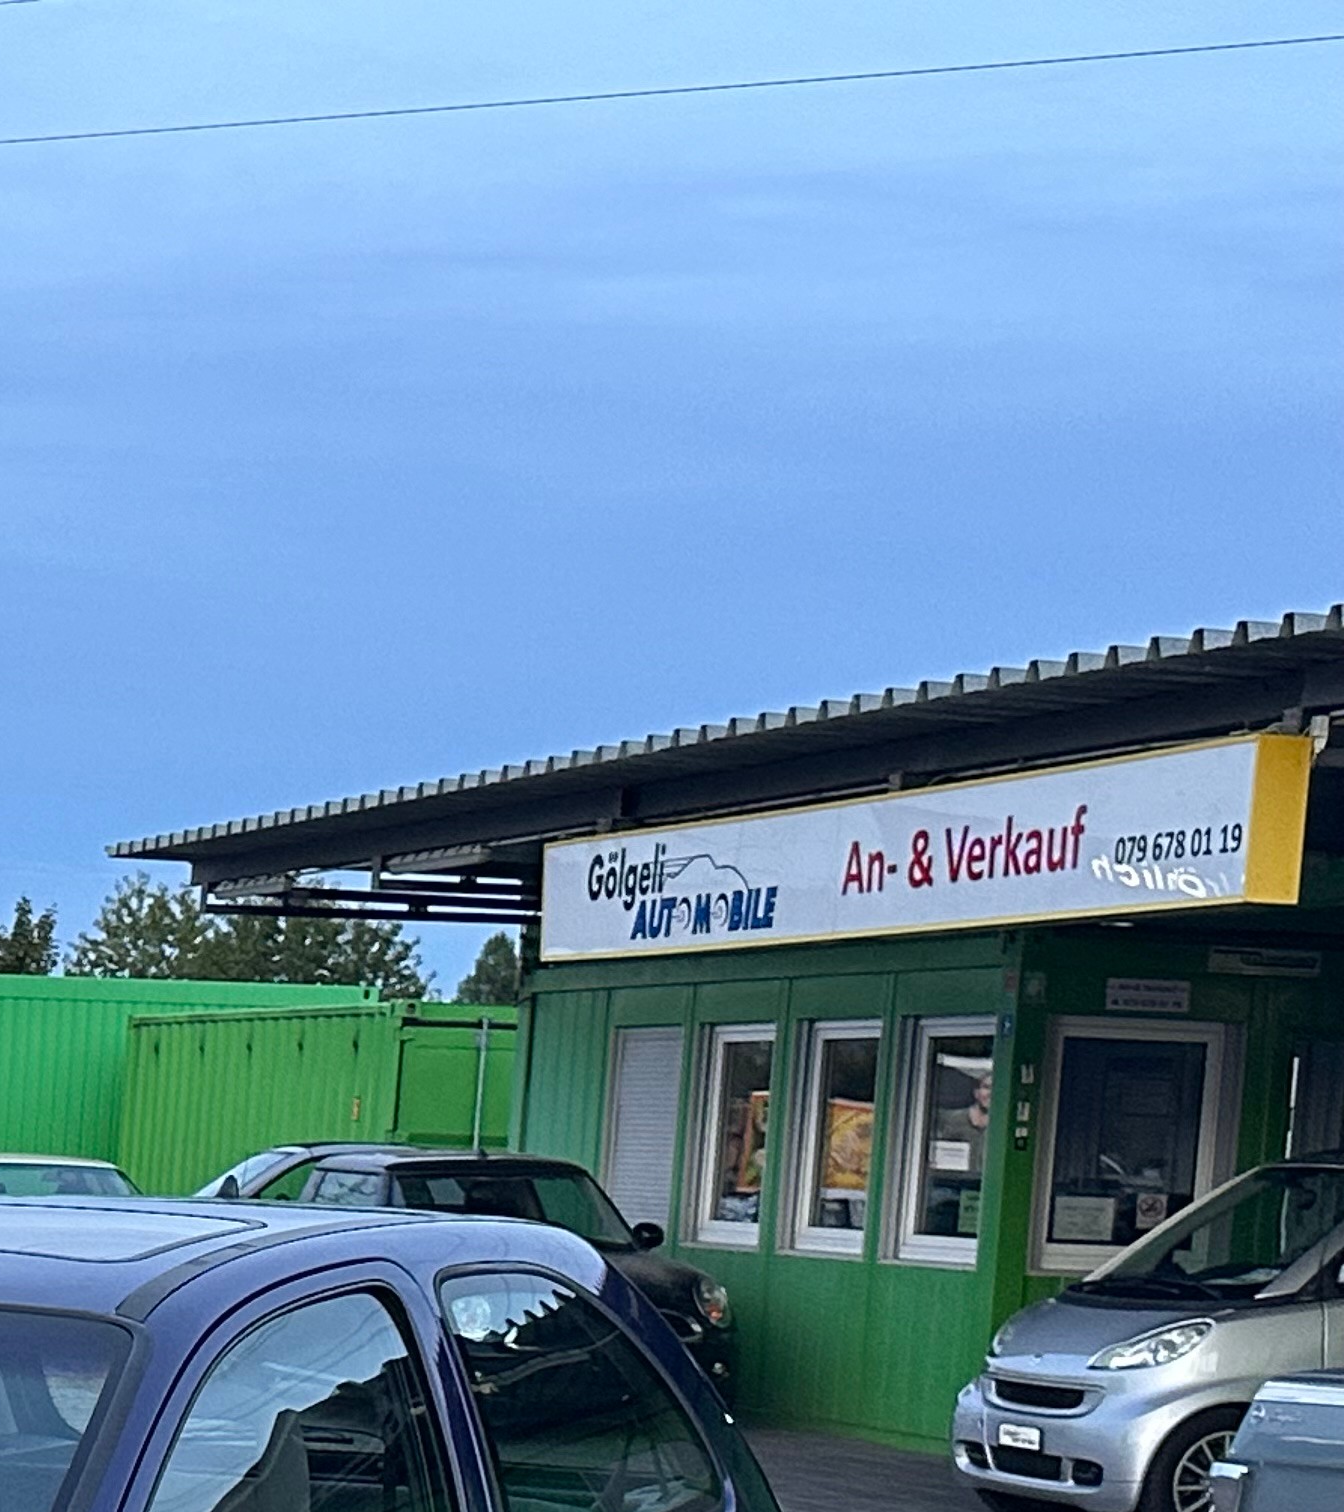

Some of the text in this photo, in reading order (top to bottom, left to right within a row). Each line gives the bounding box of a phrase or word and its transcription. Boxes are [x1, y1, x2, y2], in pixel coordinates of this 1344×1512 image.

[842, 804, 1087, 896] An- & Verkauf
[1115, 823, 1243, 865] 079 678 01 19
[588, 842, 666, 911] Gölgeli
[630, 886, 778, 940] AUTOMOBILE
